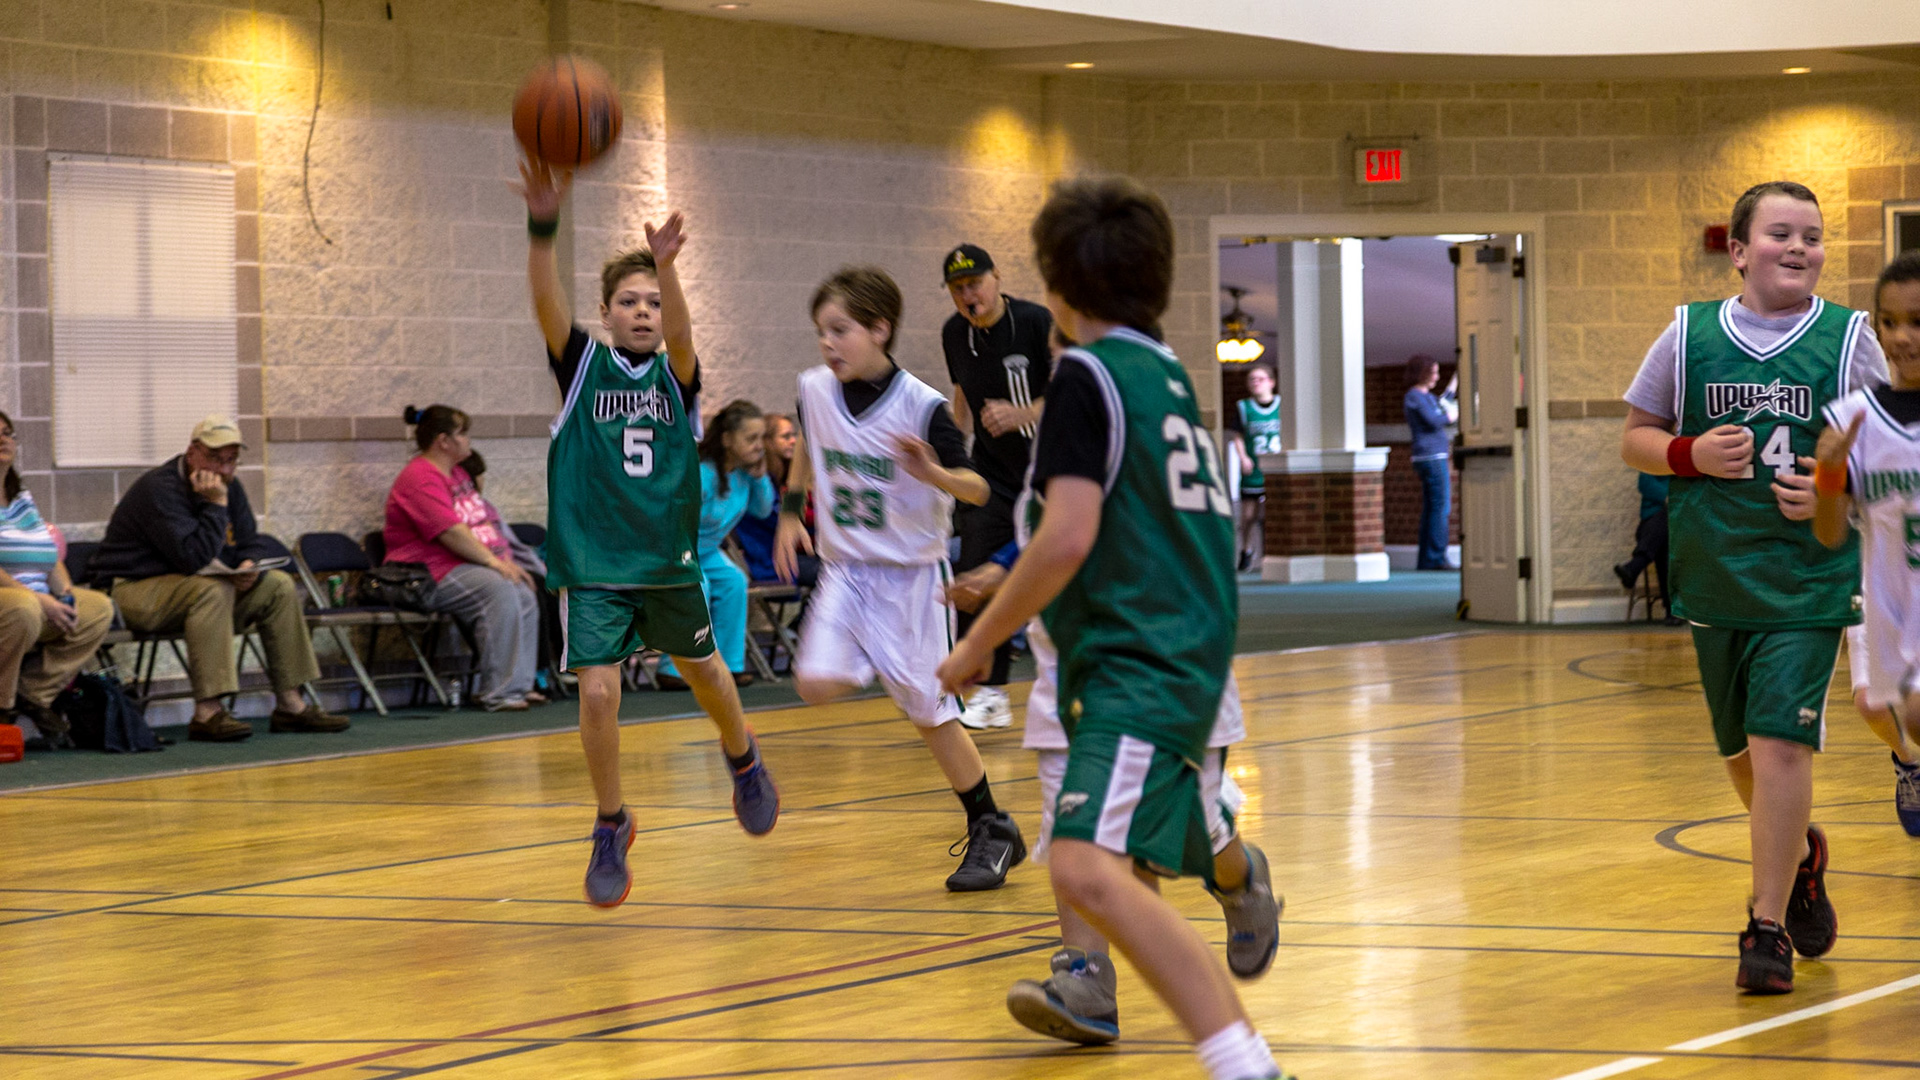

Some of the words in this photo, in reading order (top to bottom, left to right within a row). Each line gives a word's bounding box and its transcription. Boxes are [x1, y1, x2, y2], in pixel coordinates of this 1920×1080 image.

[1366, 150, 1402, 182] EXIT
[1706, 378, 1812, 422] UPWARD
[623, 426, 655, 478] 5
[1254, 434, 1281, 455] 24
[1741, 424, 1796, 480] 4
